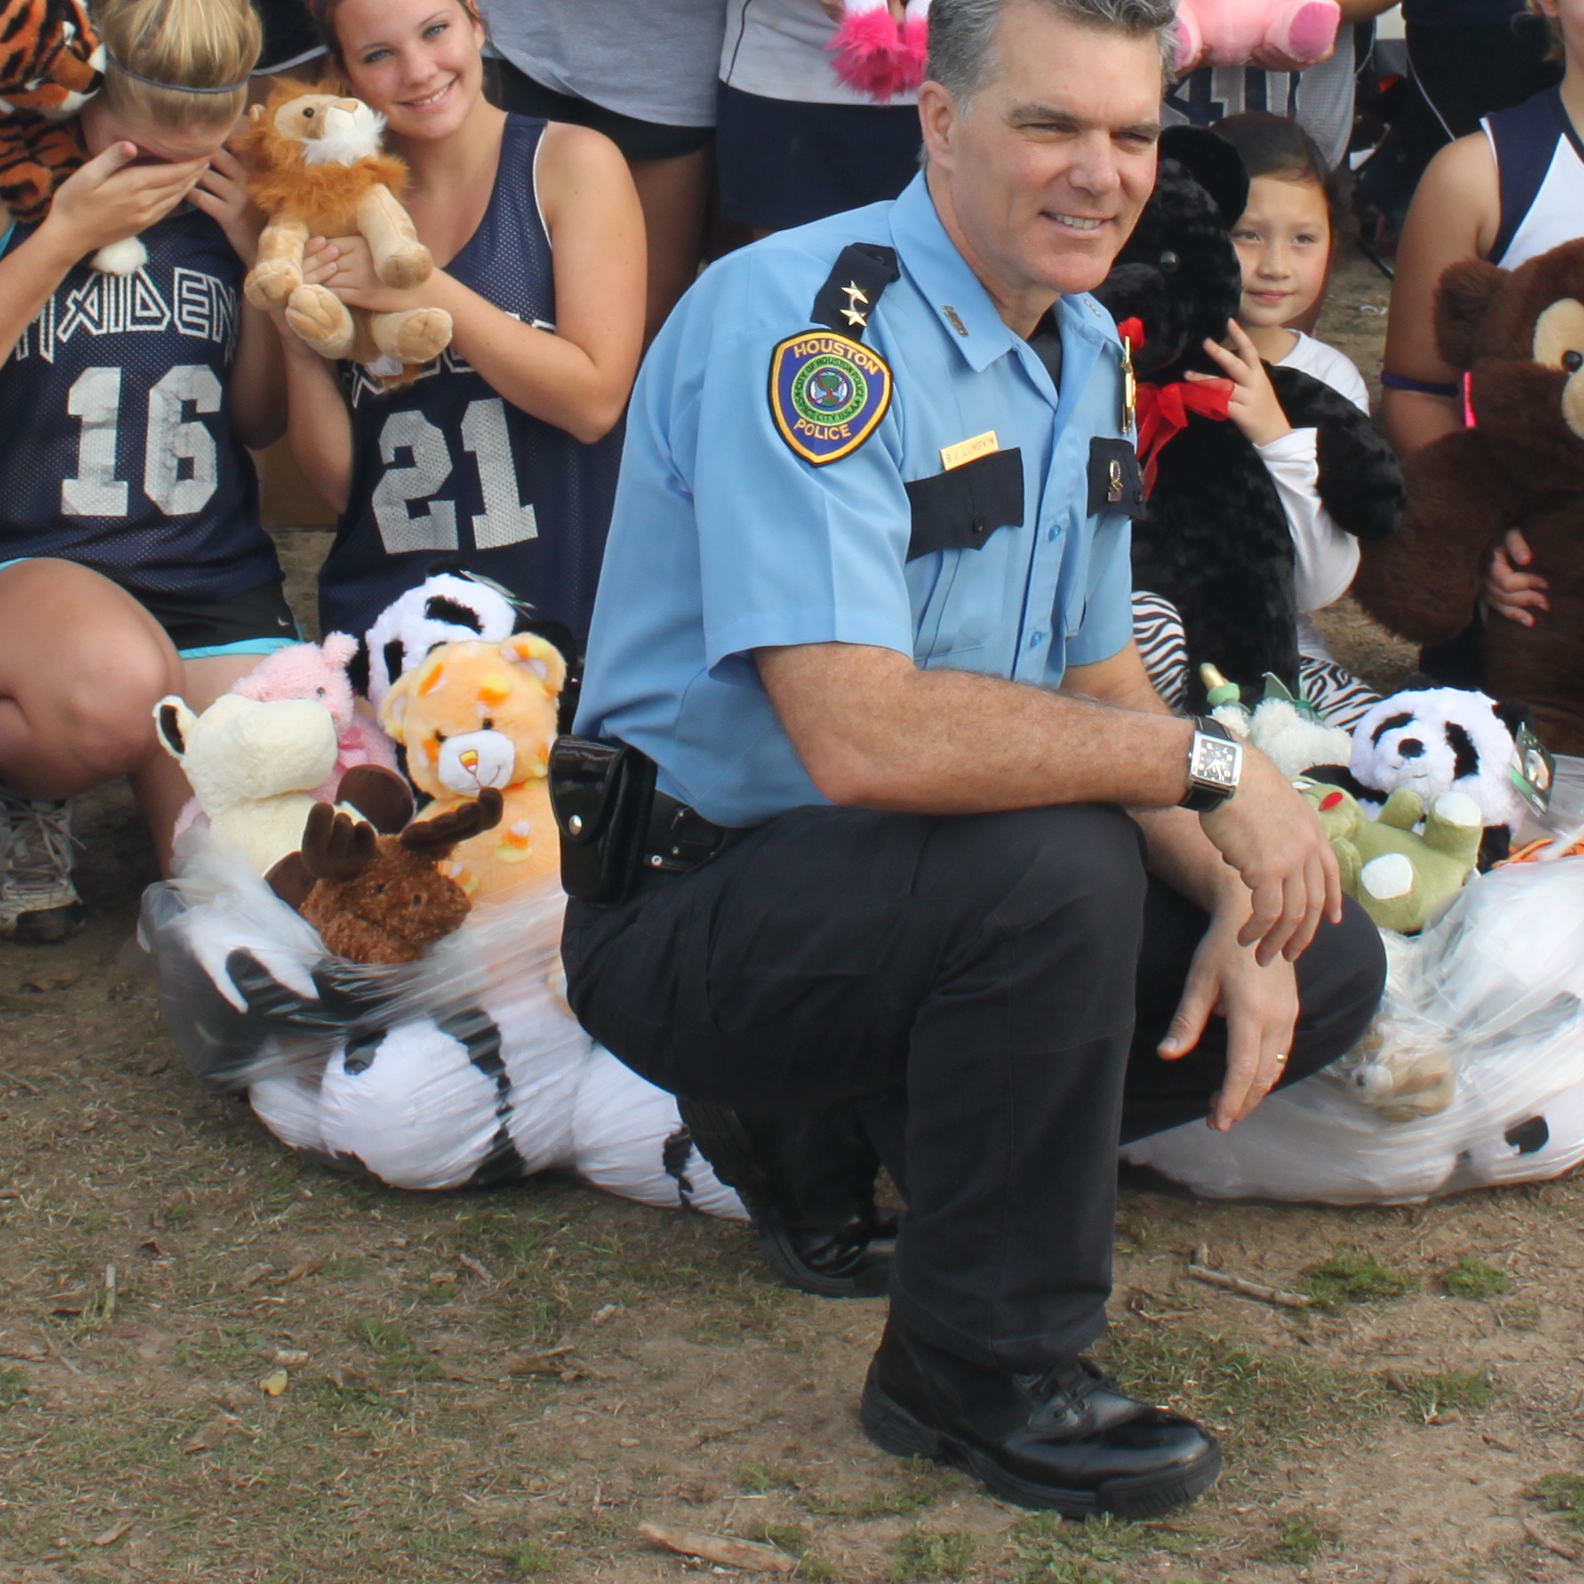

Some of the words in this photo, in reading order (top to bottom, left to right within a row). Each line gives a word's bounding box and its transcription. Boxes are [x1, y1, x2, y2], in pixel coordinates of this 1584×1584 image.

[16, 266, 240, 365] MAIDEN
[793, 339, 879, 376] HOUSTON
[60, 363, 223, 517] 16
[793, 418, 853, 441] POLICE
[963, 438, 996, 458] LUMPKIN
[371, 396, 539, 555] 21
